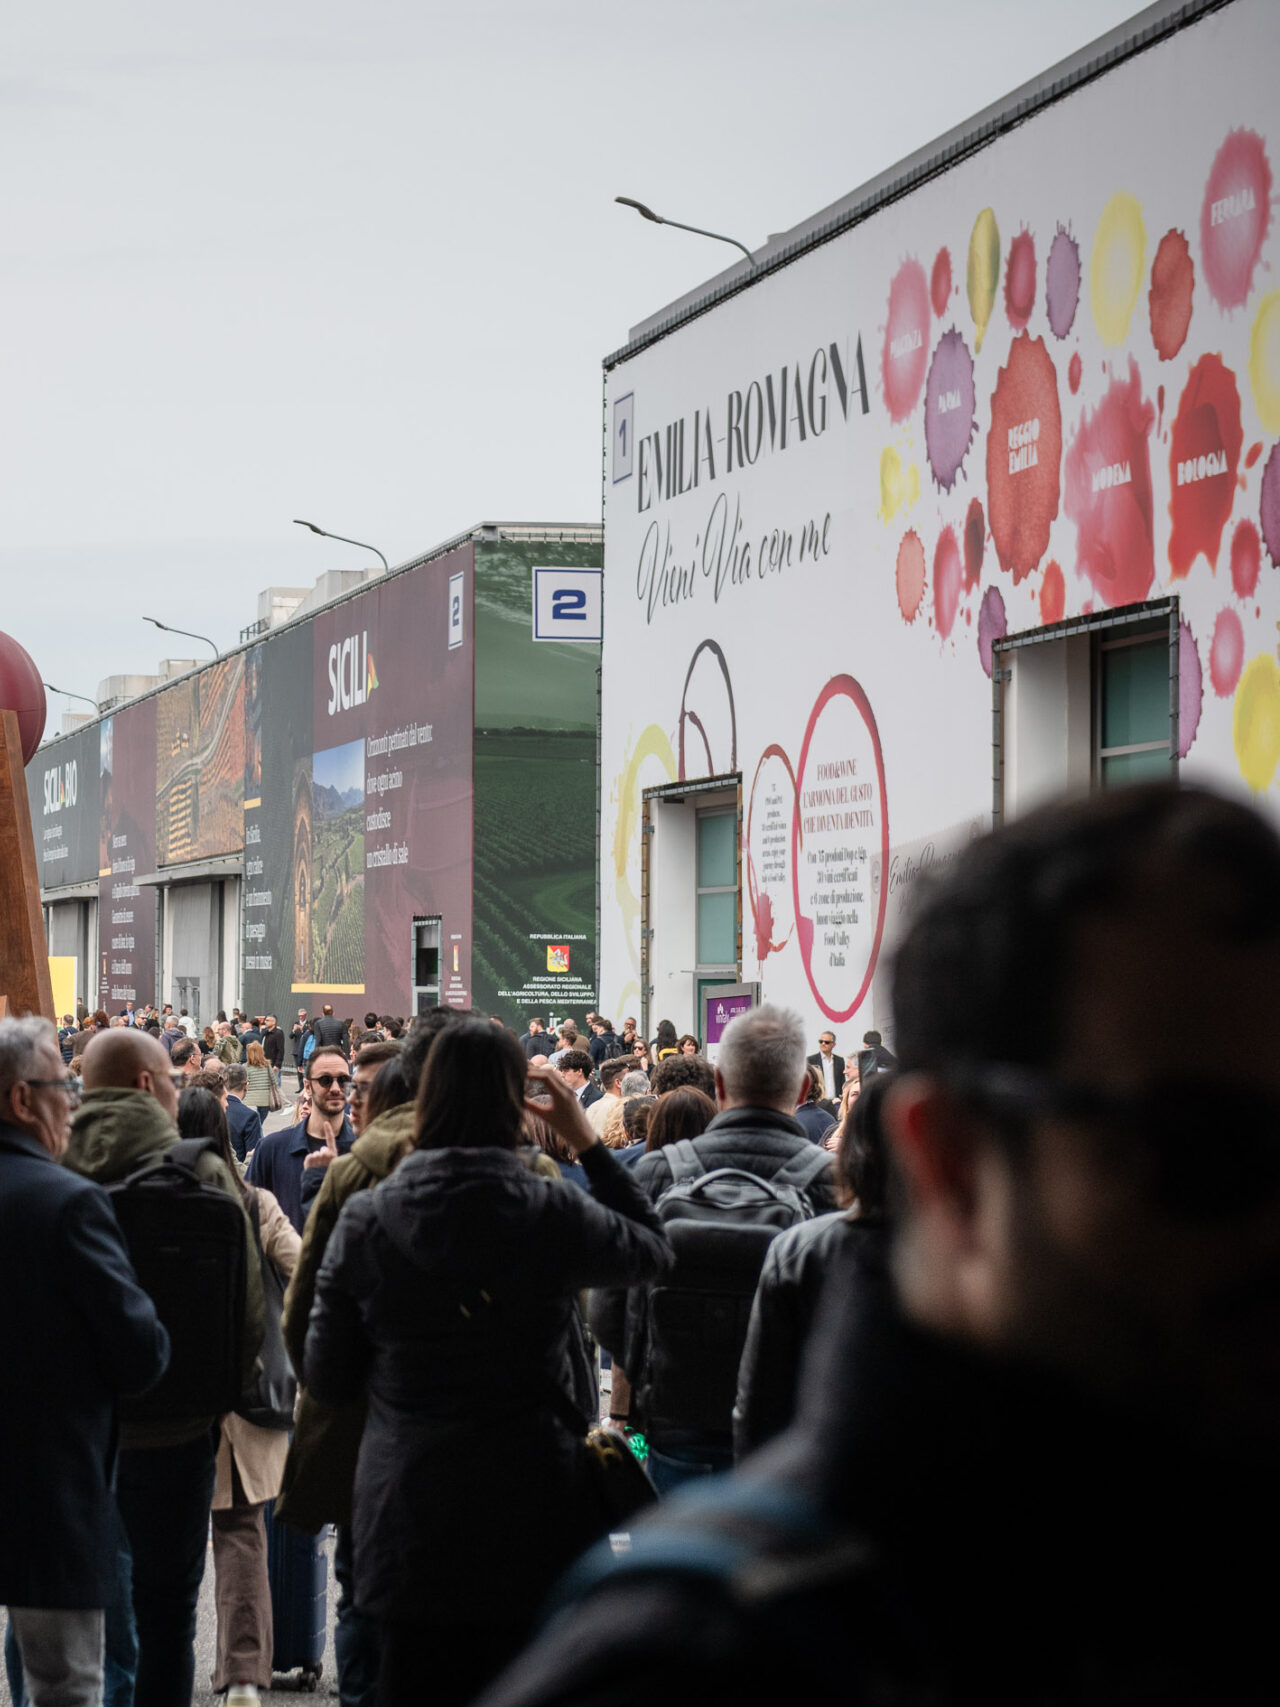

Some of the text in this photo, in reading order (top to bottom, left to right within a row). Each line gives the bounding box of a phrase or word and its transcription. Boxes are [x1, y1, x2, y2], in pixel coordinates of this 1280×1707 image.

[618, 418, 627, 457] 1
[637, 329, 871, 514] EMILIA-ROMAGNA
[1007, 417, 1040, 448] REGGIO
[1008, 443, 1039, 475] EMILIA
[1177, 449, 1229, 486] BOLOGNA
[1091, 460, 1132, 493] MODENA
[702, 491, 751, 604] Via
[758, 528, 793, 580] con
[451, 595, 460, 628] 2
[552, 589, 587, 621] 2
